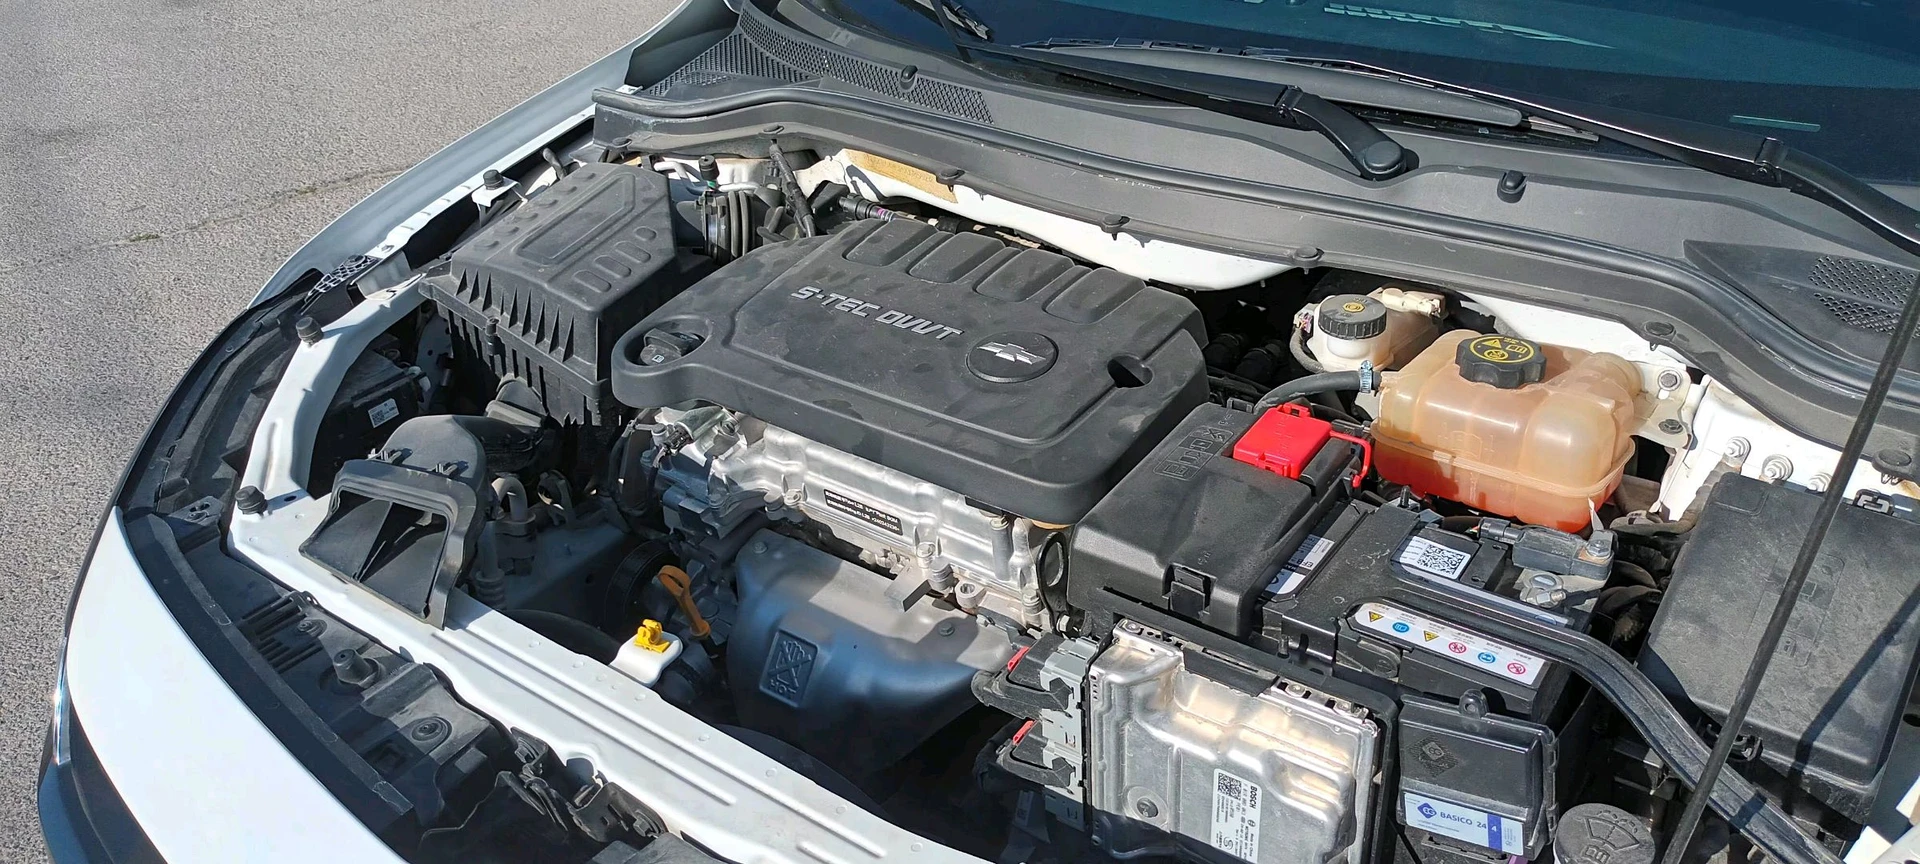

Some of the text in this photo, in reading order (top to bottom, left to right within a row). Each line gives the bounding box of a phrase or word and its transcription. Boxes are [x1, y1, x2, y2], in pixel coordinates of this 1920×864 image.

[1249, 785, 1258, 810] BOSCH
[1440, 811, 1473, 826] BASICO
[1476, 821, 1487, 830] 24
[1491, 825, 1497, 833] 4
